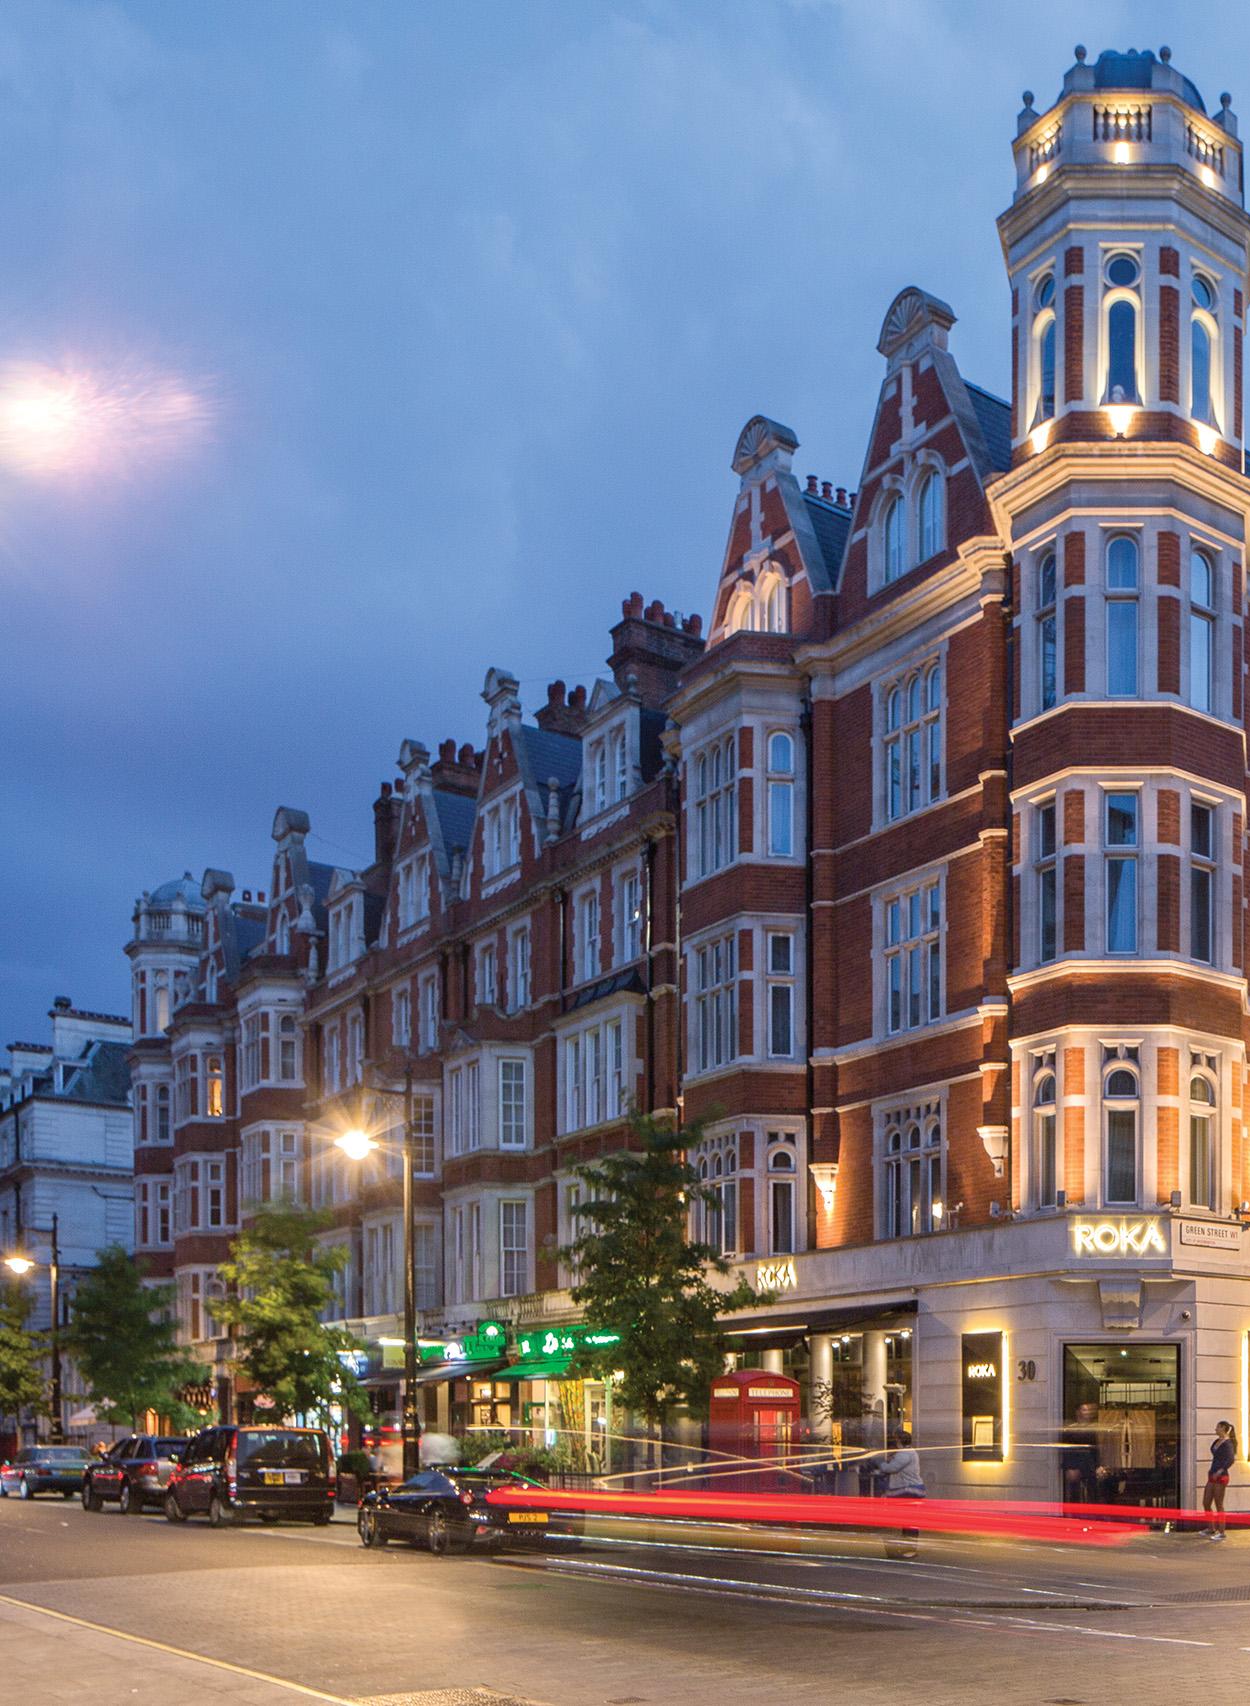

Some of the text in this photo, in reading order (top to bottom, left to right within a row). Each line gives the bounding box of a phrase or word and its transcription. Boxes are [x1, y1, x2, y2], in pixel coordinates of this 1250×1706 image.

[1074, 1220, 1166, 1254] ROKA
[1185, 1225, 1239, 1239] GREEN STREET W1
[757, 1262, 798, 1291] ROKA
[968, 1363, 996, 1378] ROKA
[1018, 1360, 1036, 1381] 30
